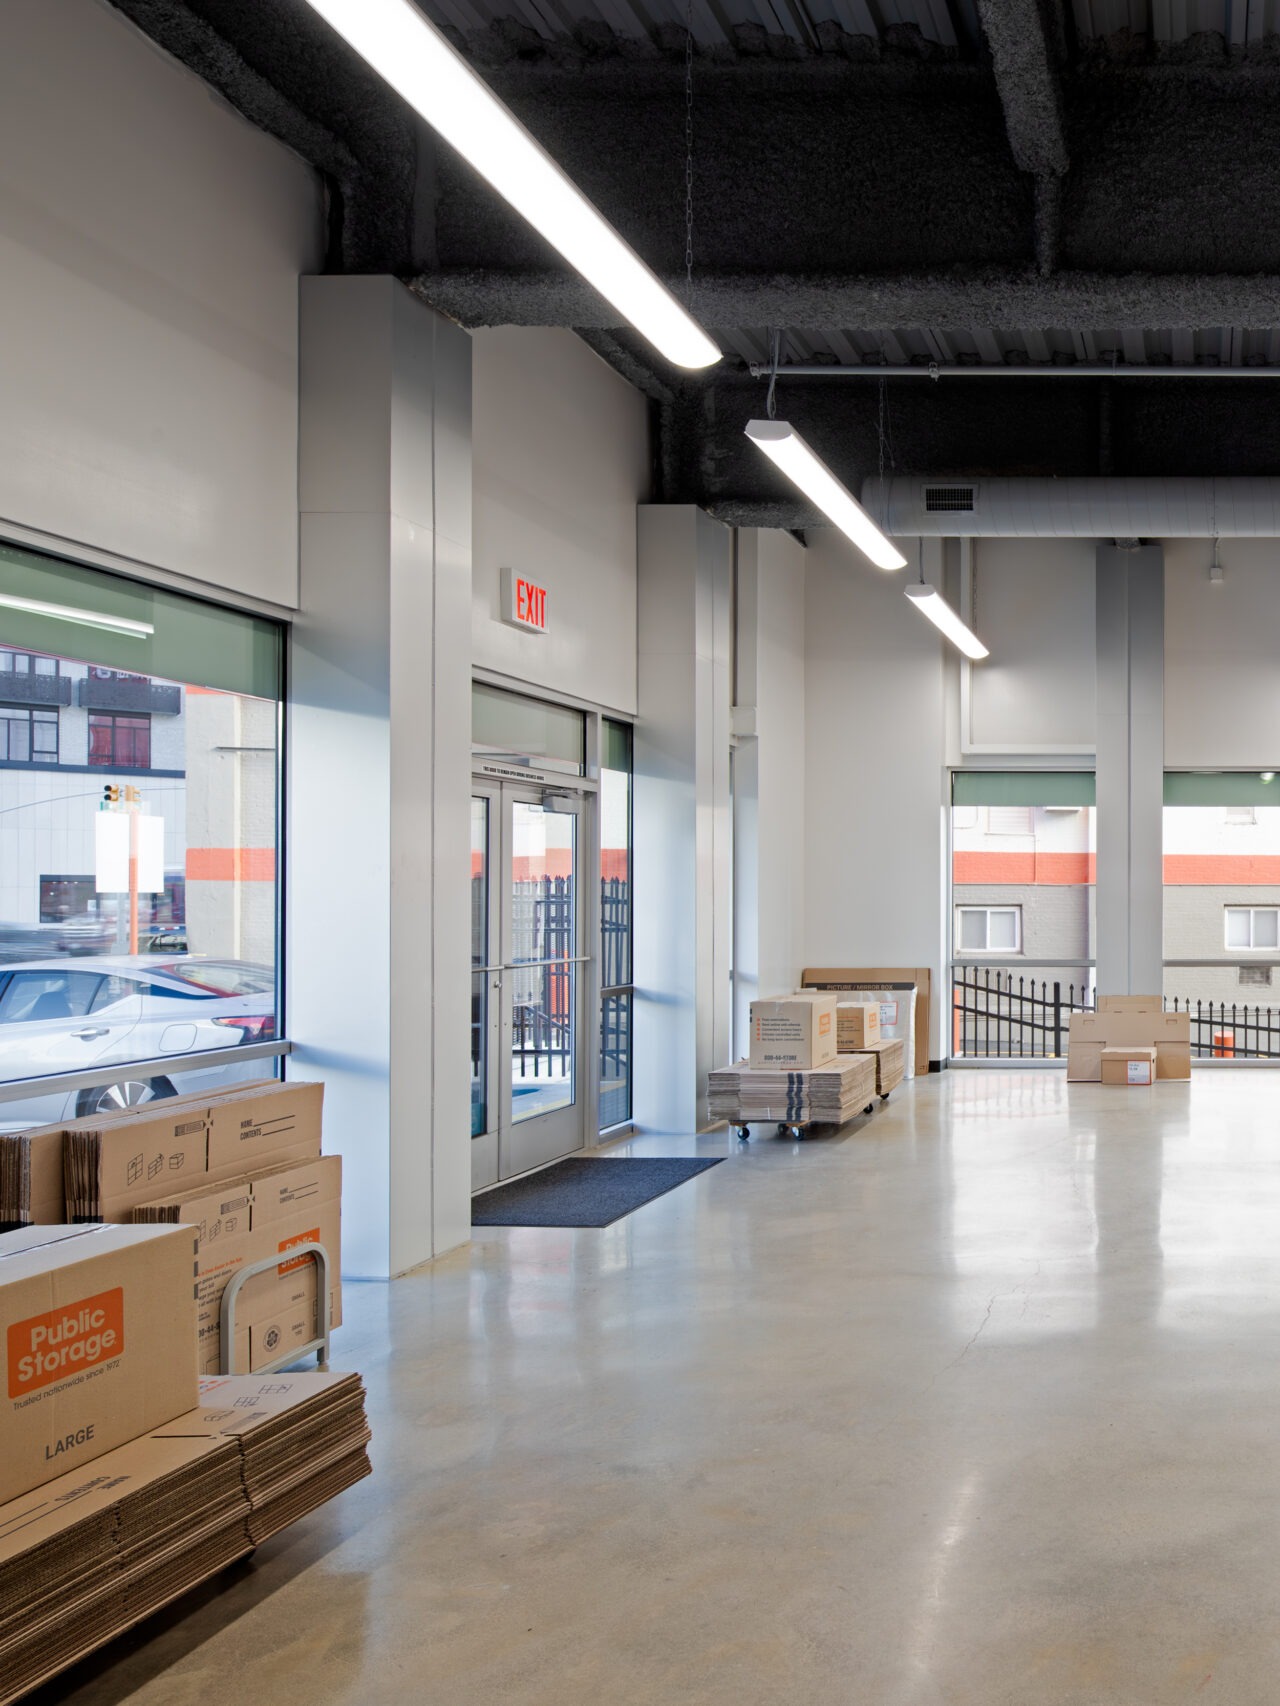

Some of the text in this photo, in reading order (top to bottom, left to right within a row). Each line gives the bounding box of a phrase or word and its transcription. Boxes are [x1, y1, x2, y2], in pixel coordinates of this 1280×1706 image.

[516, 578, 546, 629] EXIT
[240, 1128, 262, 1141] CONTENTS
[31, 1308, 105, 1352] Public
[18, 1329, 116, 1382] Storage
[13, 1393, 42, 1411] Trusted
[43, 1375, 84, 1398] nationwide
[86, 1367, 104, 1380] since
[45, 1424, 95, 1460] LARGE
